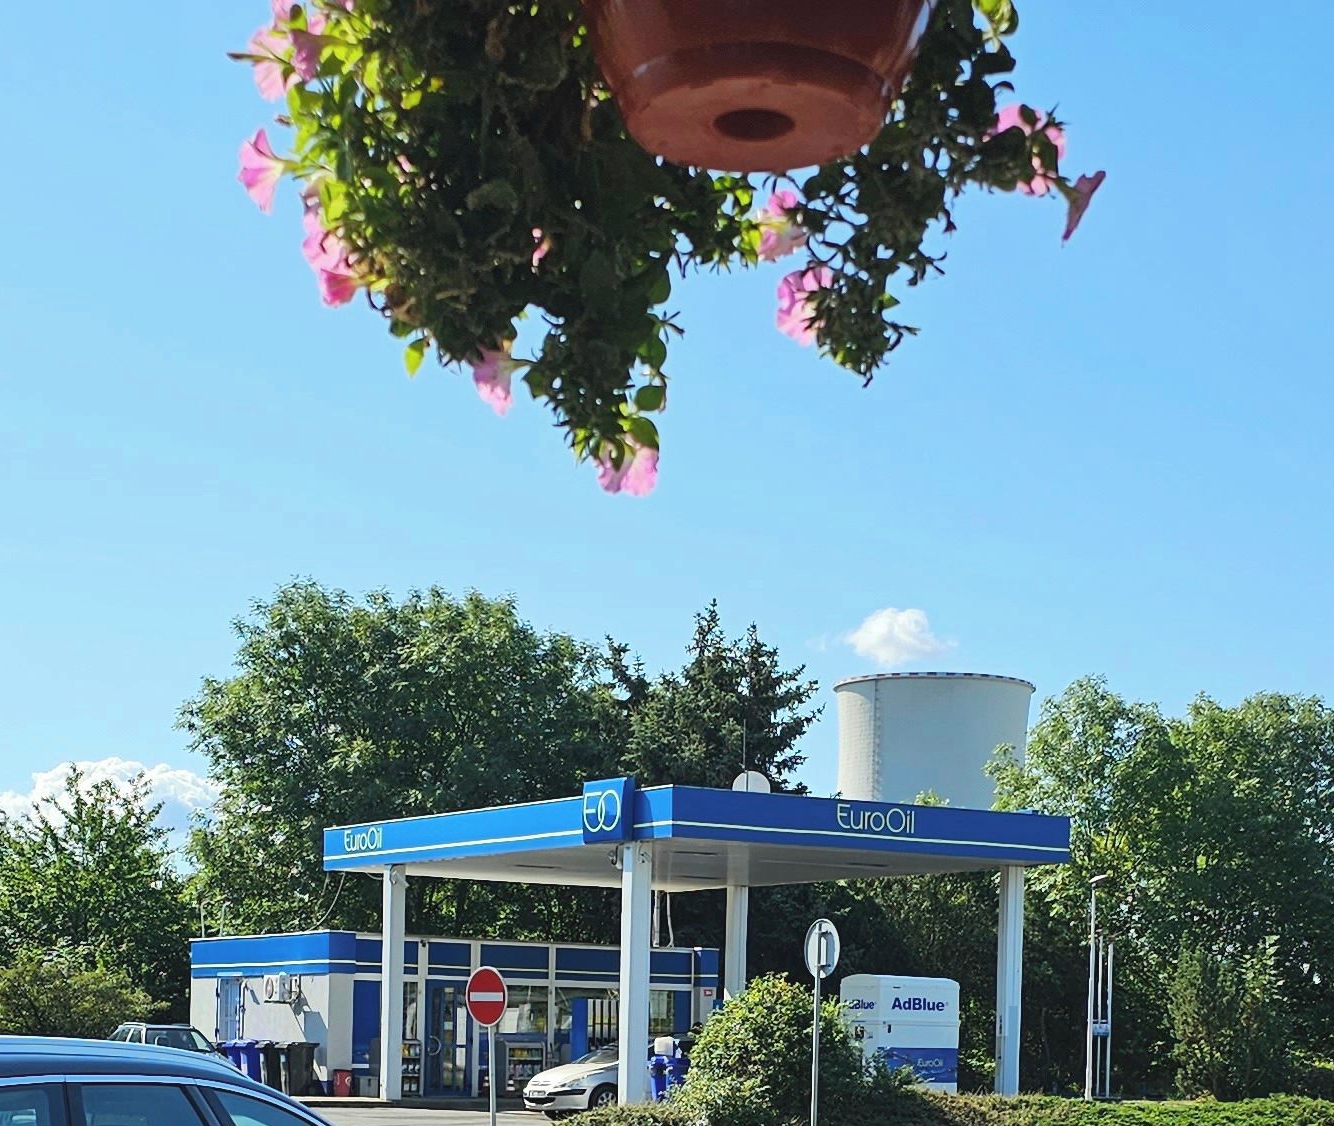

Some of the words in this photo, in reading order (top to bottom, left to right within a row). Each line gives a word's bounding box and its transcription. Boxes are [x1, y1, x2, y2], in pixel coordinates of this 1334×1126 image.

[837, 803, 915, 834] EuroOil
[344, 826, 383, 851] EuroOil
[892, 997, 945, 1011] AdBlue
